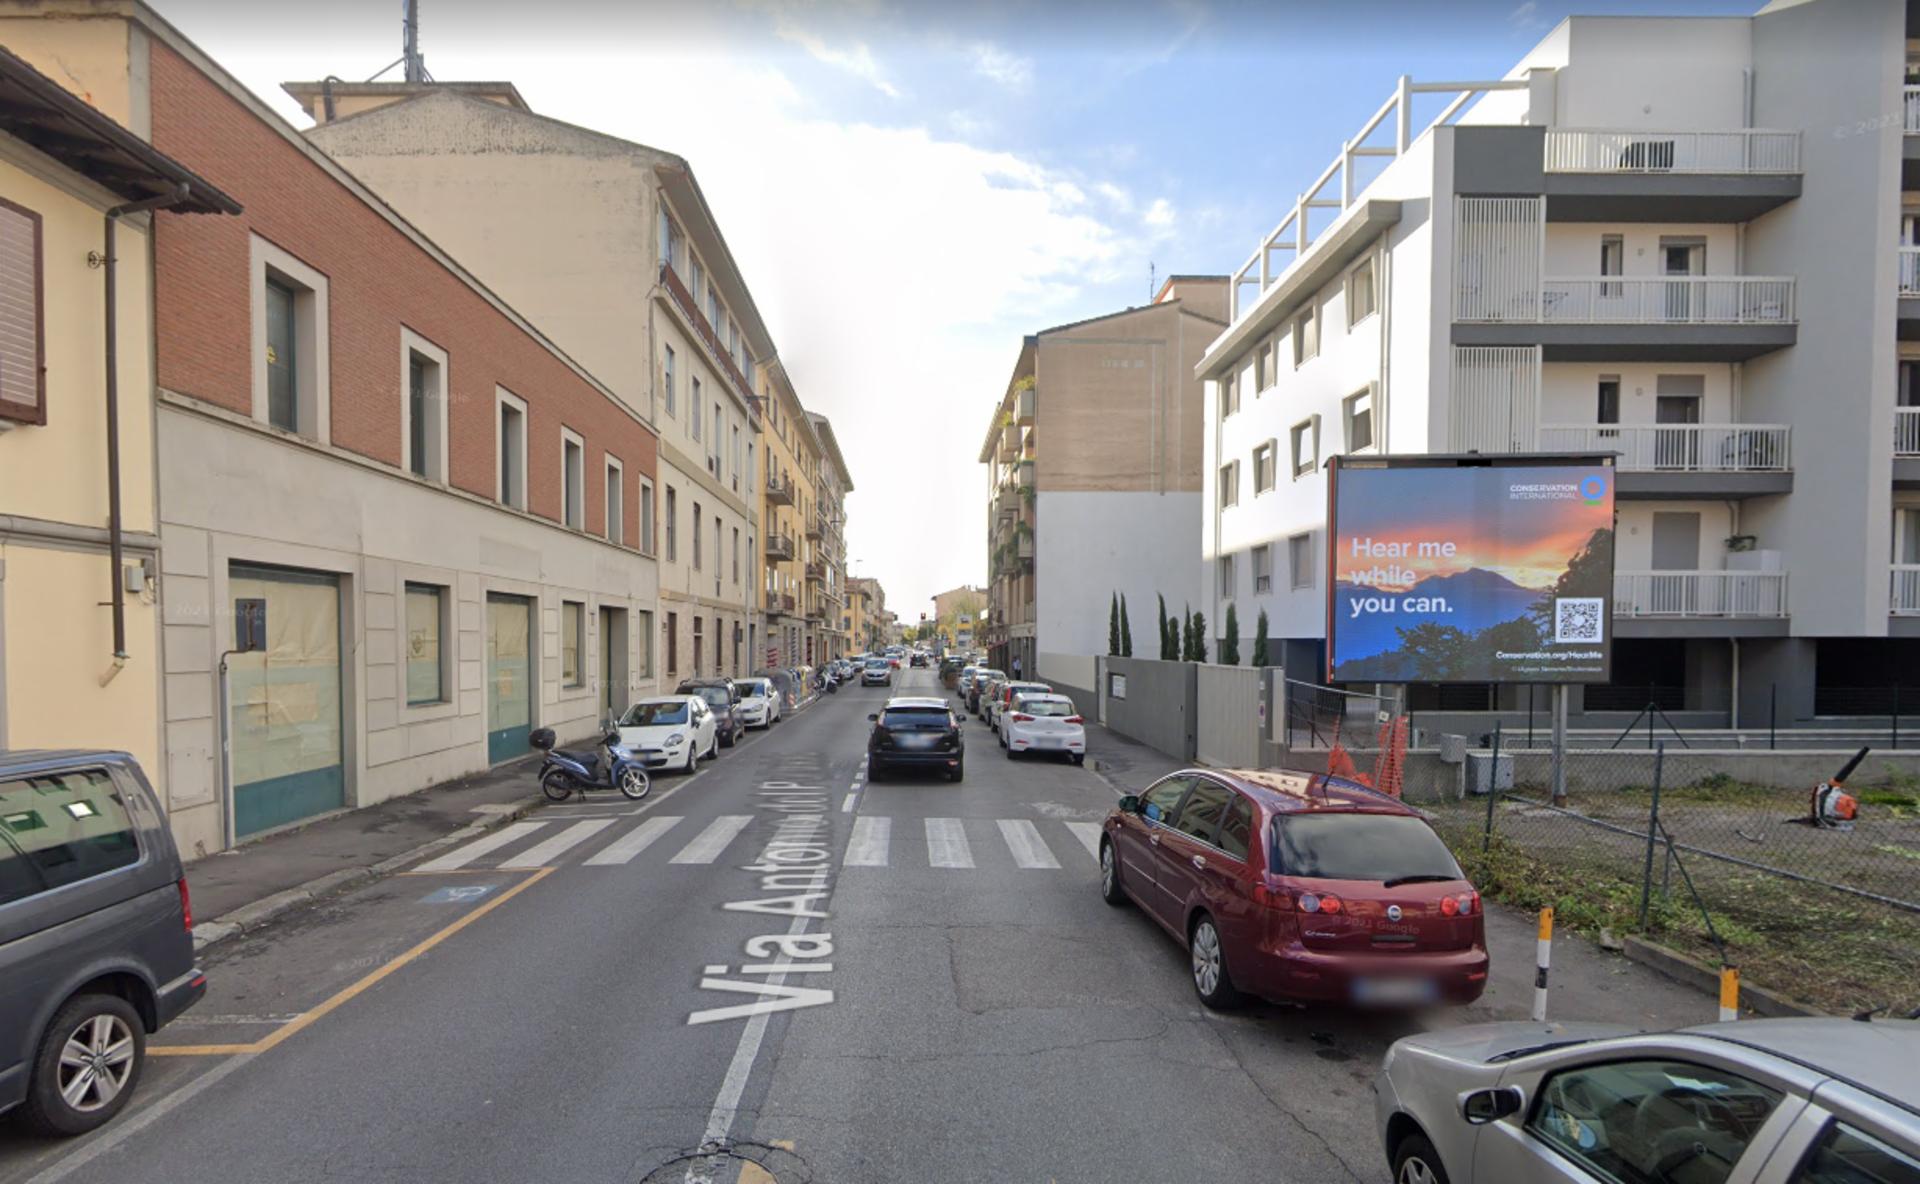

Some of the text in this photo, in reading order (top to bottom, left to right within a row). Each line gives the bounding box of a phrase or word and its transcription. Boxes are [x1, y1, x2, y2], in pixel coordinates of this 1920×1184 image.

[1510, 484, 1578, 492] CONSERVATION
[1510, 492, 1577, 500] INTERNATIONAL
[1352, 537, 1457, 558] Hear me
[1351, 565, 1416, 585] while
[1350, 596, 1453, 618] you can.
